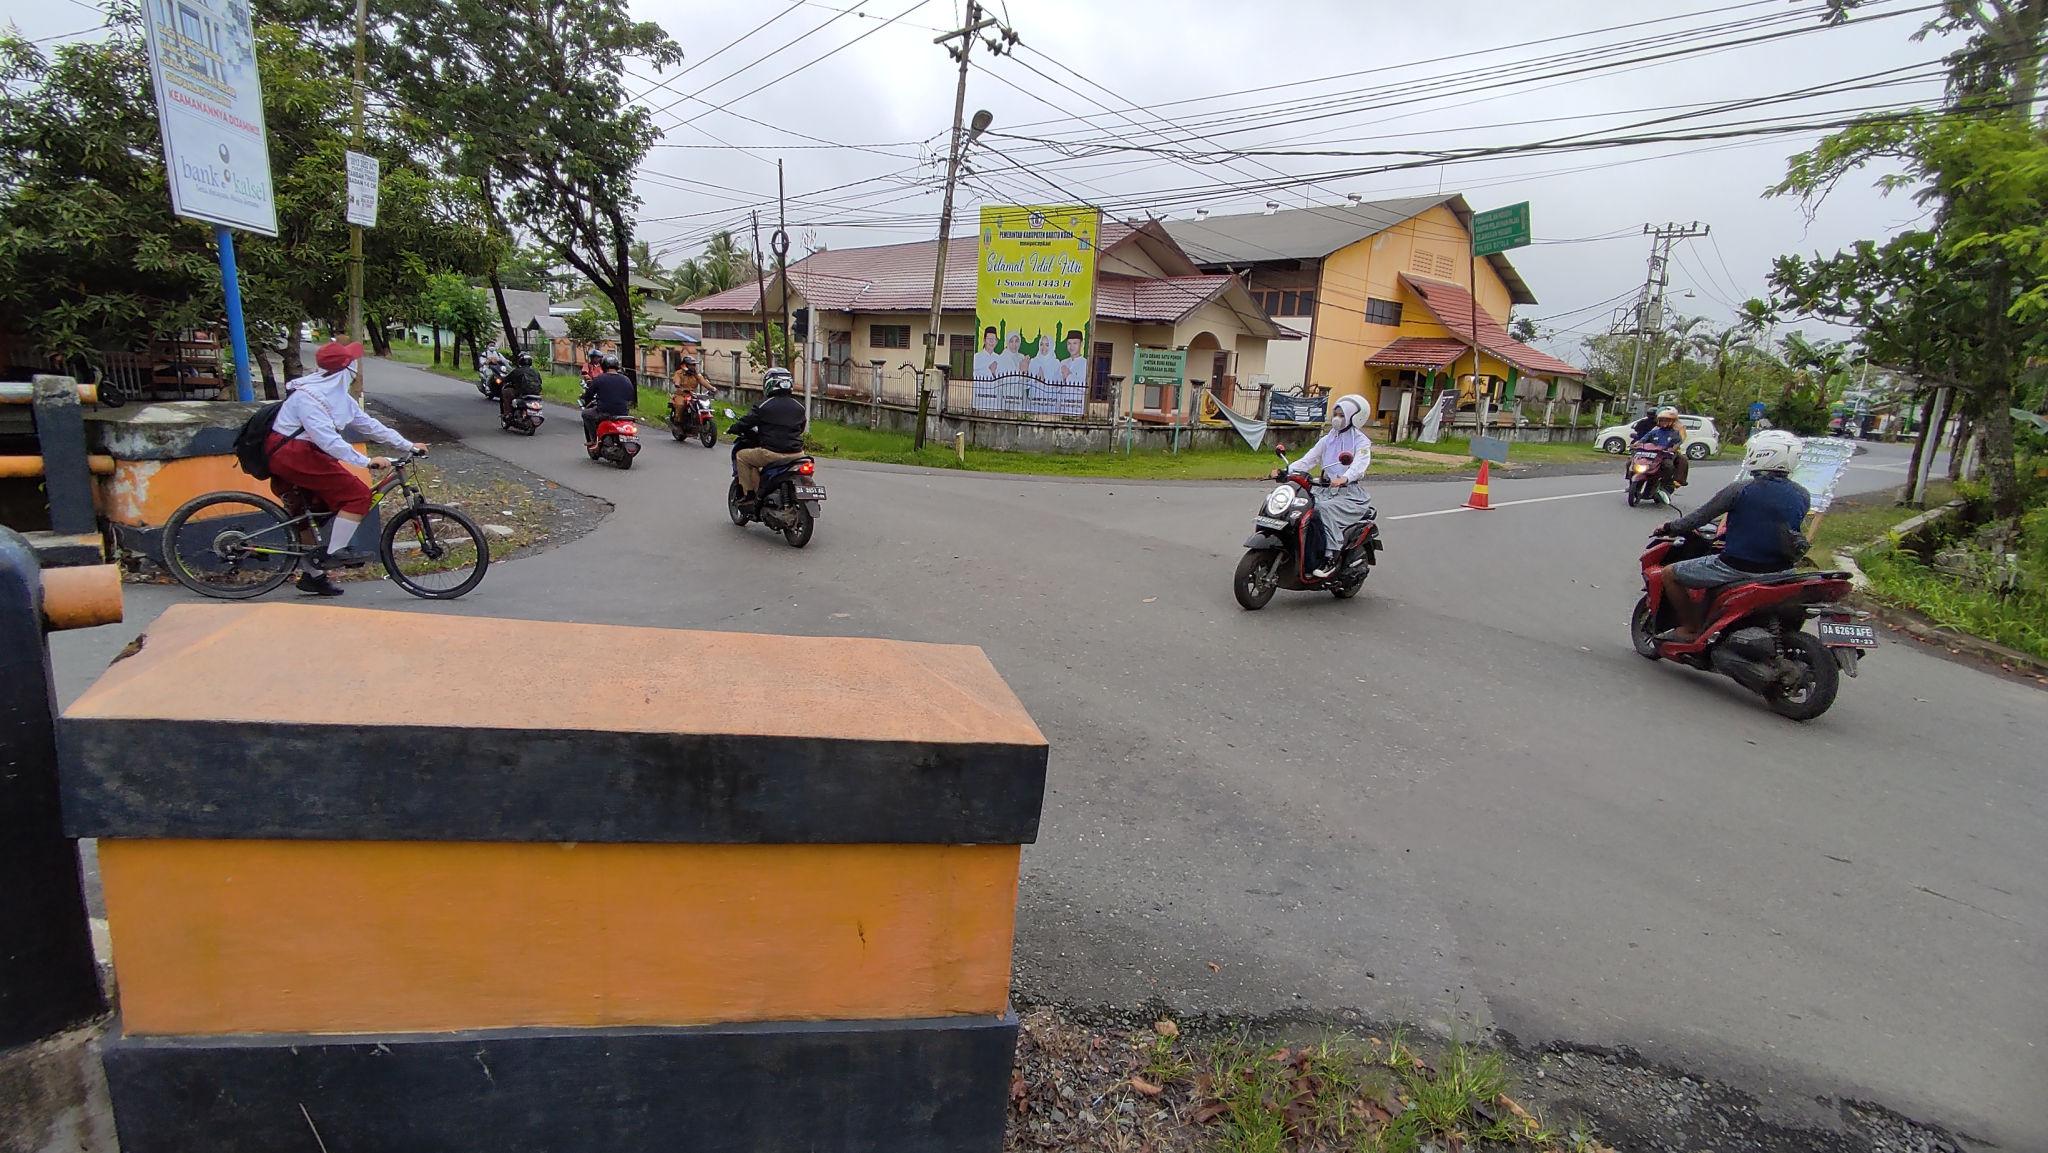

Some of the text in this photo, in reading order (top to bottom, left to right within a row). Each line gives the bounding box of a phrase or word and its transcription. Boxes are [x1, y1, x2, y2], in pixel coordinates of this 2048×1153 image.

[168, 88, 230, 123] KEAMANANNYA
[181, 156, 219, 187] bank
[233, 172, 266, 201] kalsel
[1000, 231, 1022, 239] PEMERINTAH
[1023, 231, 1045, 239] KABUPATEN
[1045, 231, 1060, 239] BARITO
[987, 251, 1024, 273] Selamat
[1058, 252, 1083, 275] Fitri
[1004, 279, 1034, 287] Syawal
[1063, 280, 1071, 288] H
[1812, 448, 1841, 457] Wedding
[1823, 625, 1873, 637] DA 6263 AFE
